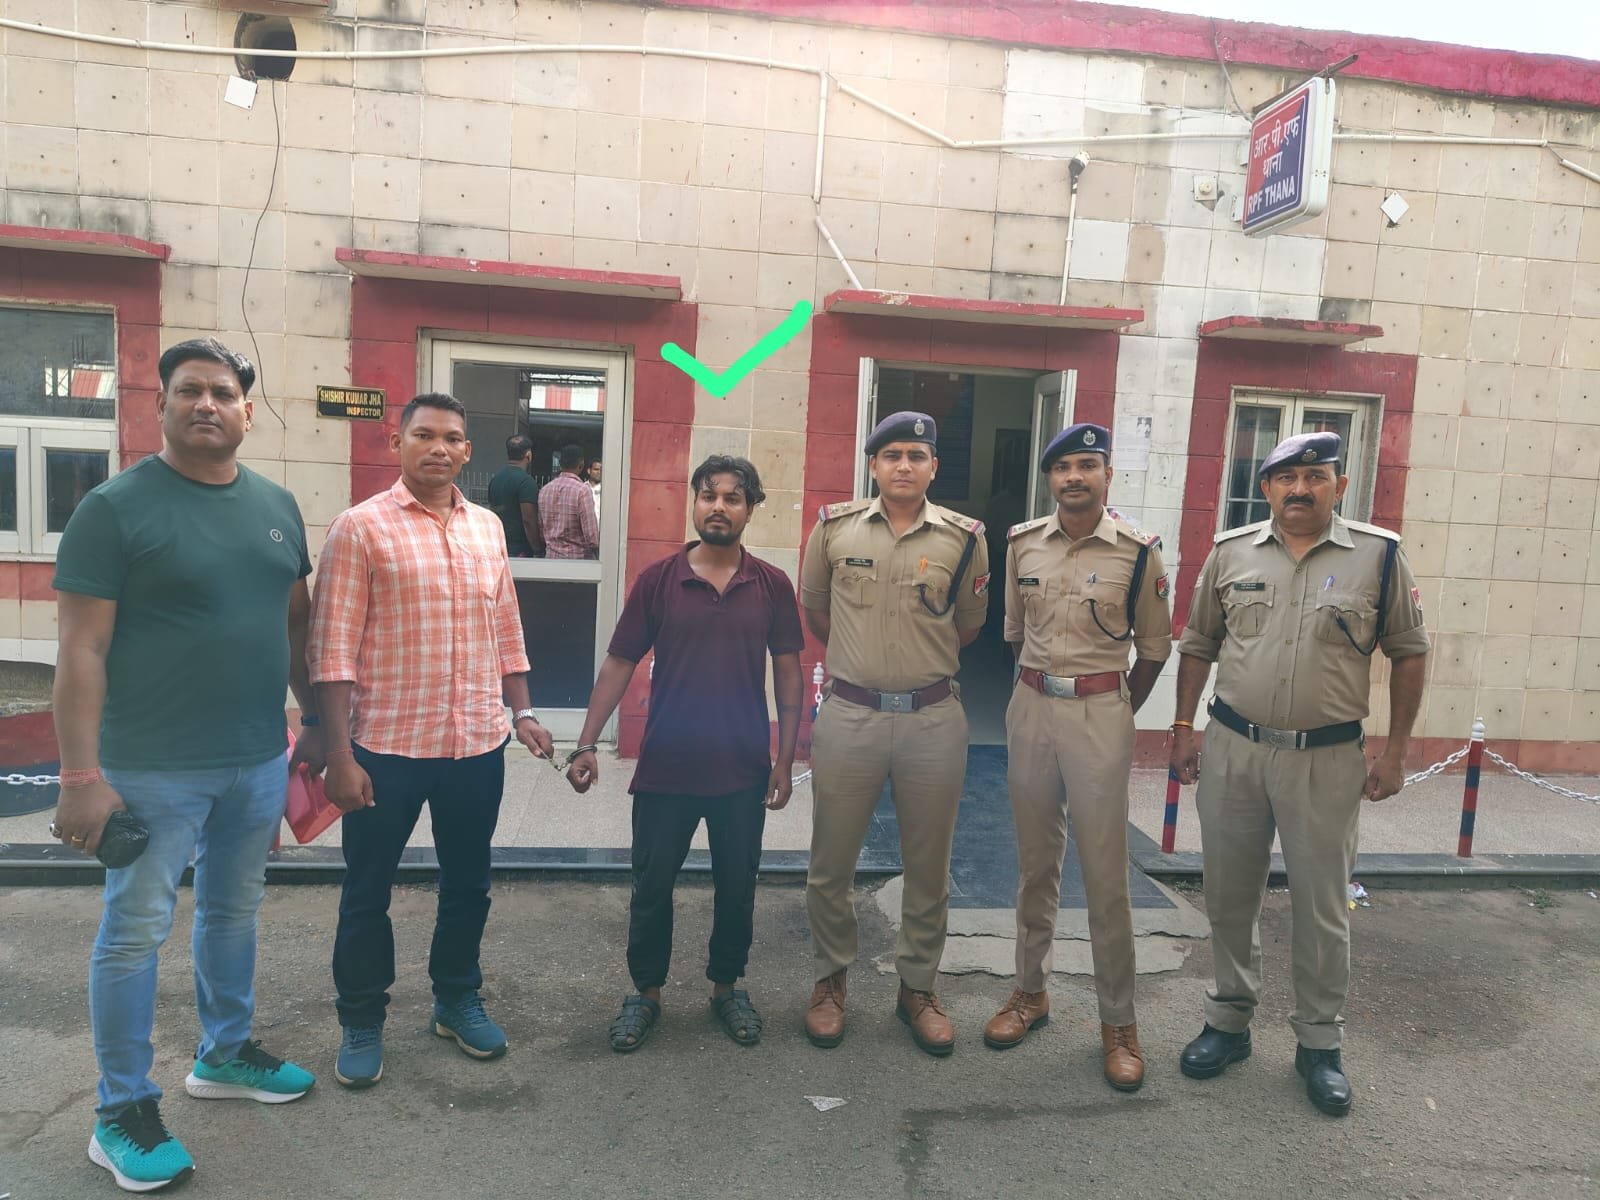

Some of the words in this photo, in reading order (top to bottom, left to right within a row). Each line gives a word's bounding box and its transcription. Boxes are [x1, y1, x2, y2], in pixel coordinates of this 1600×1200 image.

[1263, 151, 1283, 178] थाना
[1247, 190, 1263, 215] RPF
[1264, 175, 1295, 207] THANA
[320, 390, 345, 403] SHISHIR
[345, 391, 368, 405] KUMAR
[368, 393, 382, 406] JHA
[346, 406, 381, 416] INSPECTOR
